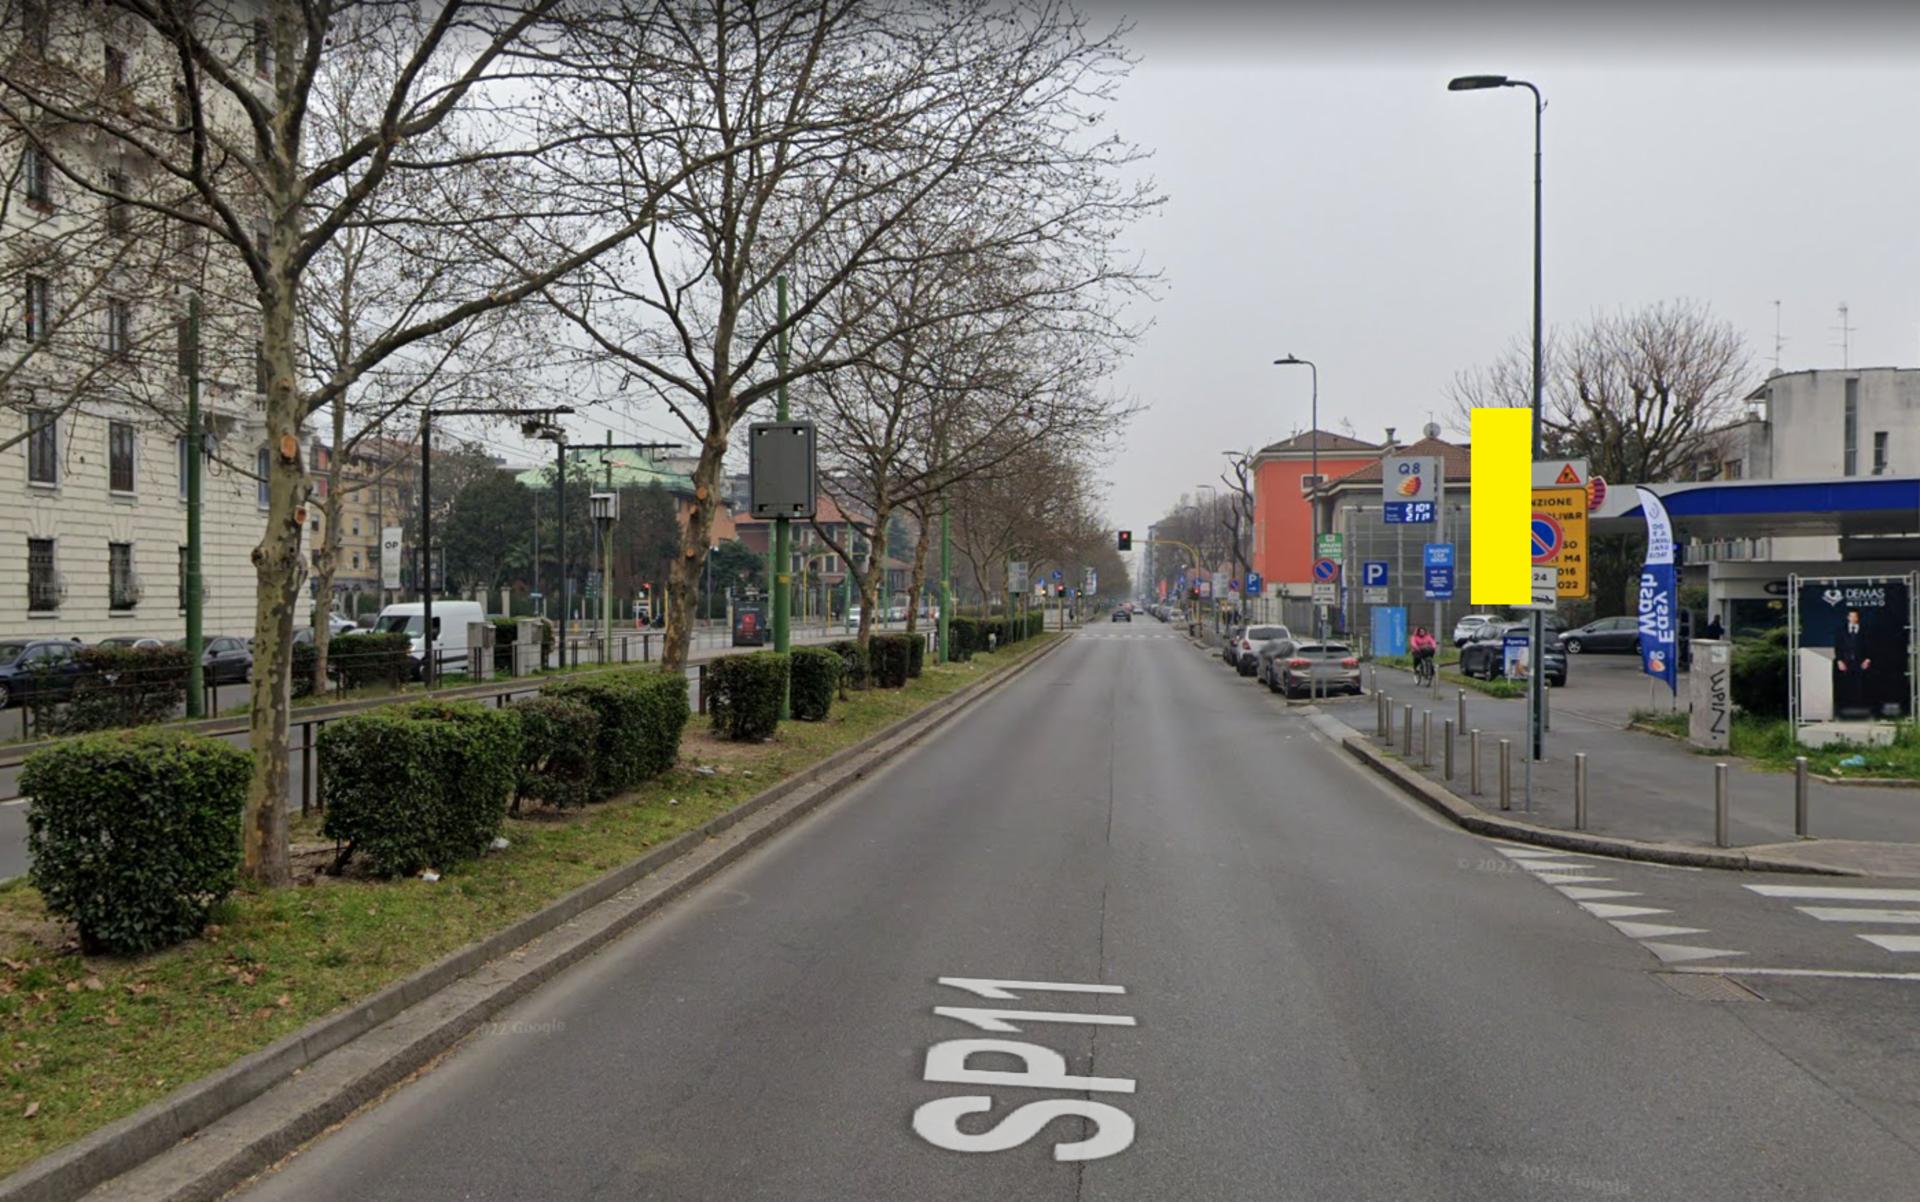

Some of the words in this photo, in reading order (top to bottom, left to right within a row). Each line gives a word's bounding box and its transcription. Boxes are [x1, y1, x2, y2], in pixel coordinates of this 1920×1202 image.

[1398, 462, 1421, 474] Q8
[1564, 554, 1581, 563] M4
[1368, 564, 1384, 584] P
[1845, 588, 1885, 599] DEMAS
[912, 977, 1137, 1161] SP11
